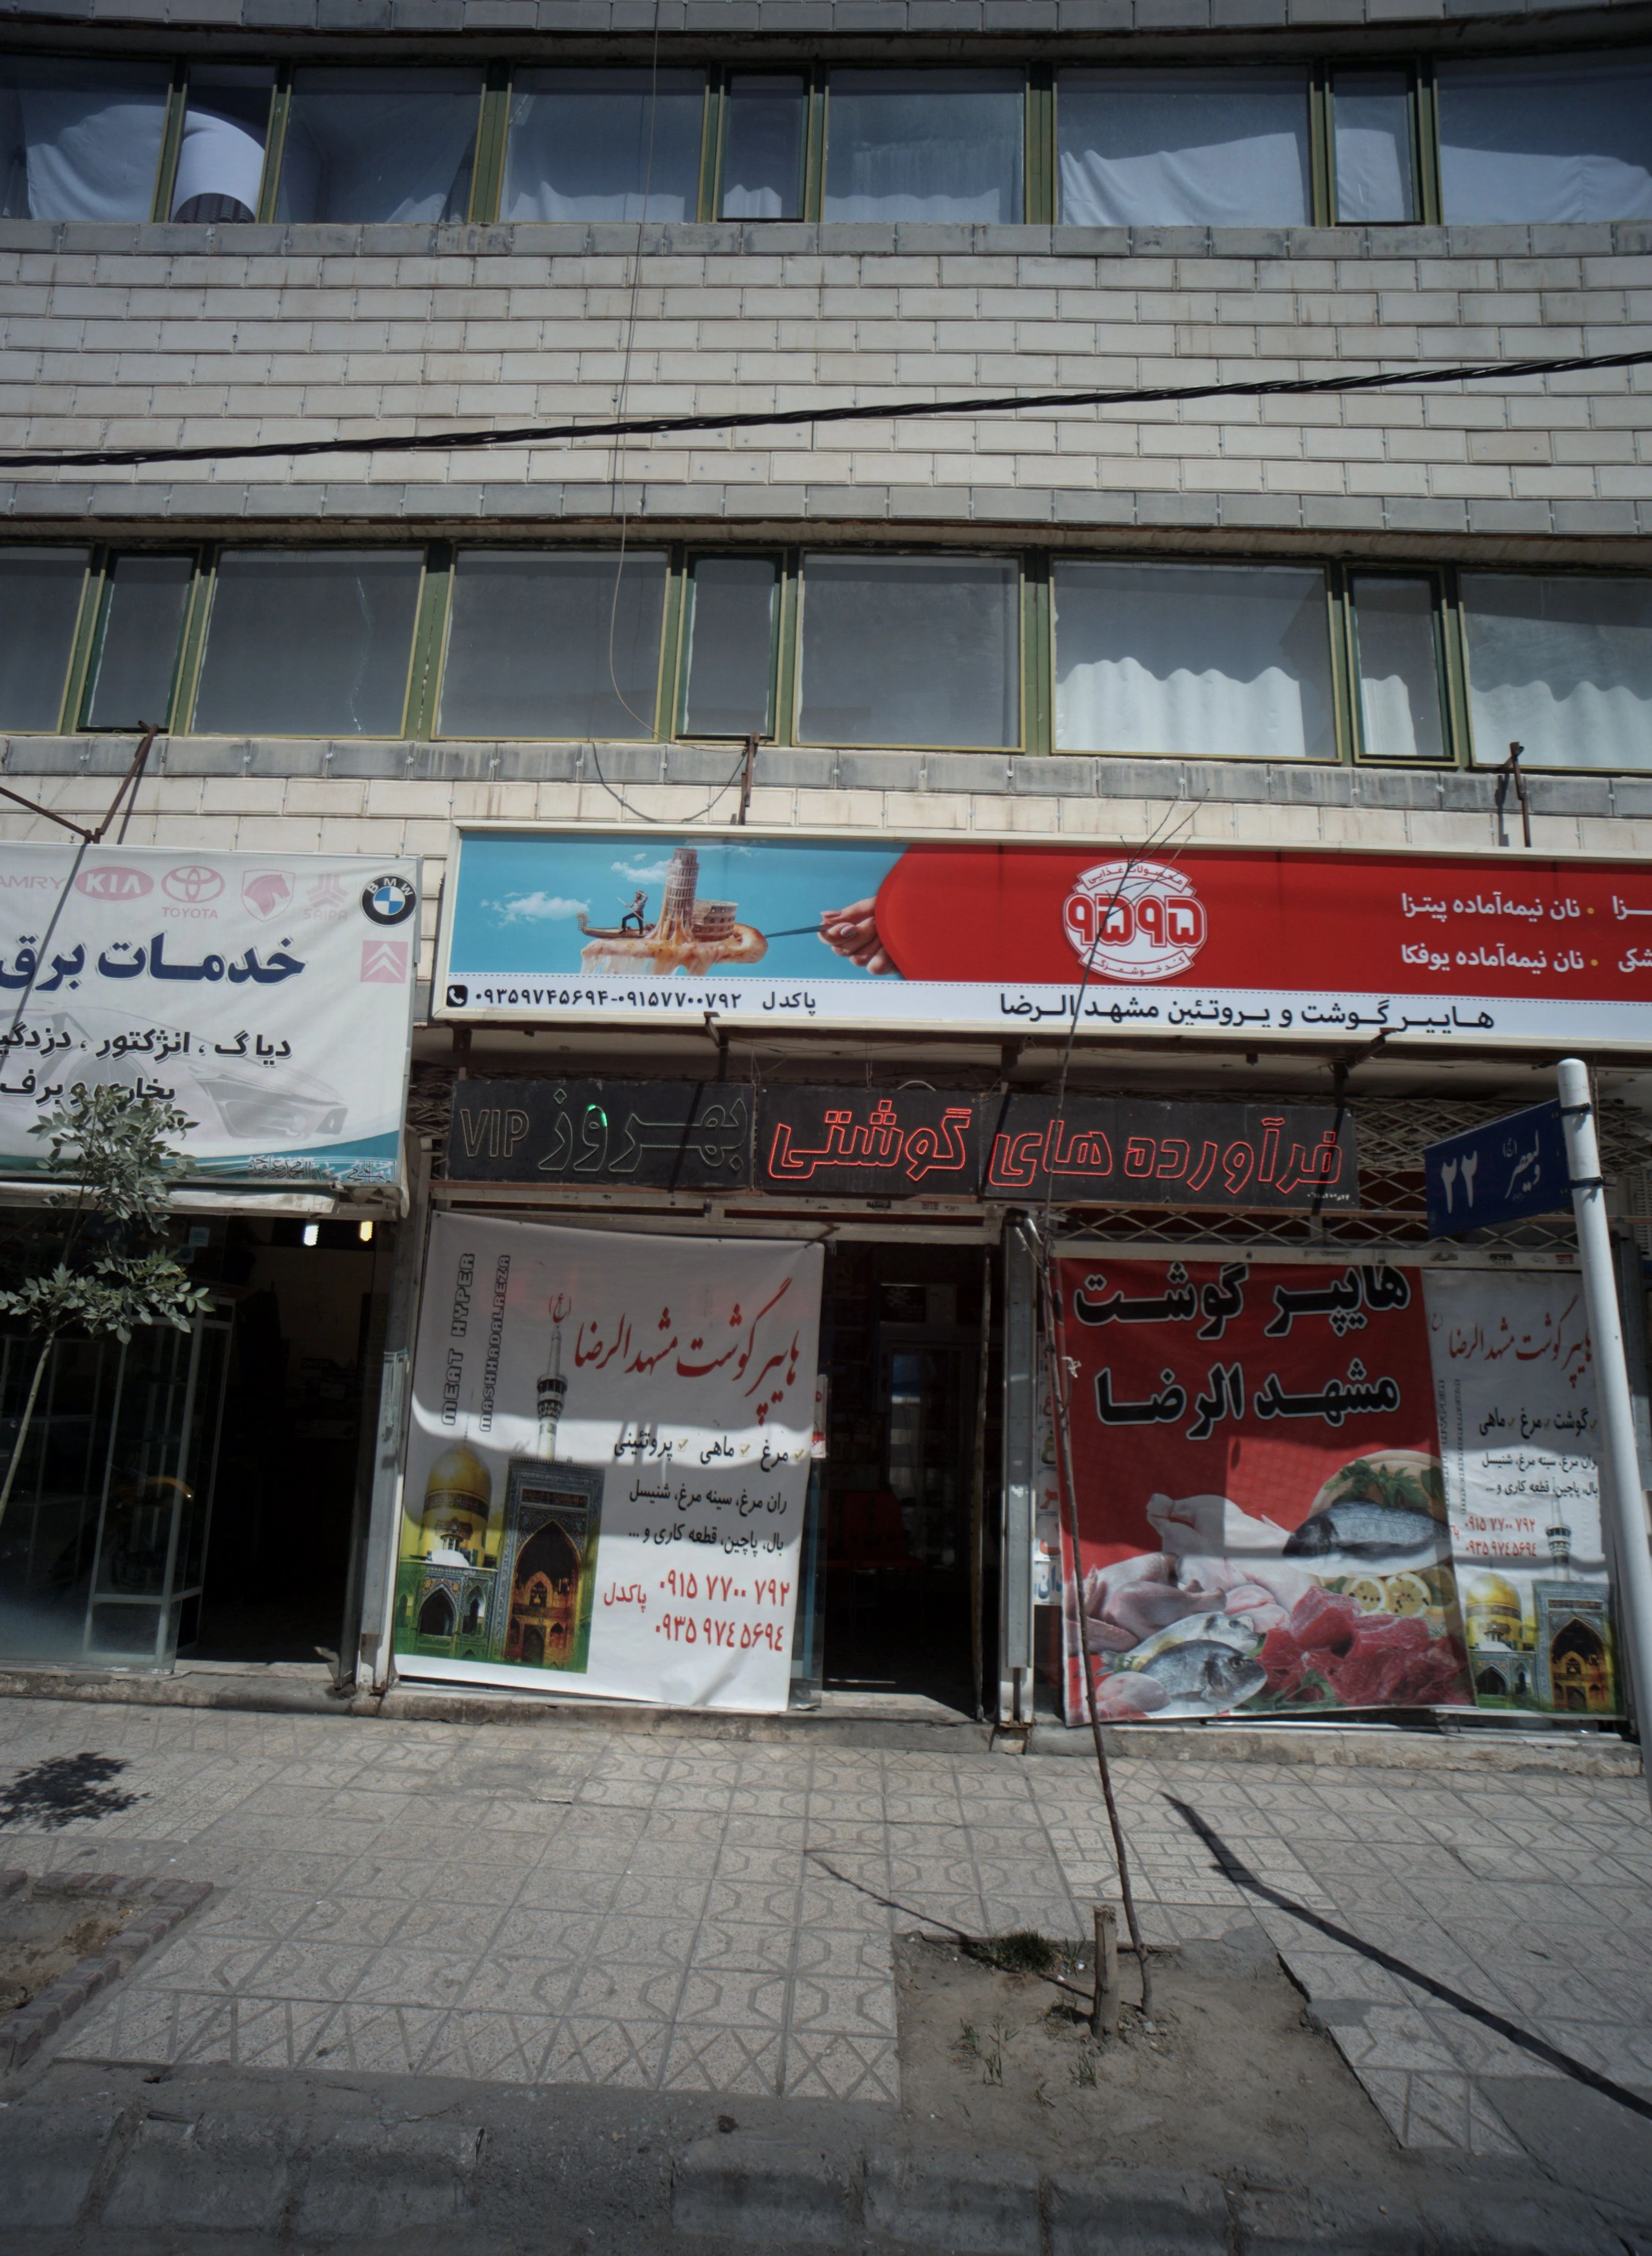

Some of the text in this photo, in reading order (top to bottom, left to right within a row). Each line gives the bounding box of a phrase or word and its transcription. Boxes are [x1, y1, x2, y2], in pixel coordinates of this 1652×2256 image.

[86, 874, 142, 893] KIA
[366, 877, 413, 897] BMW
[162, 907, 219, 919] TOYOTA
[303, 909, 348, 921] SAIPA
[1067, 895, 1203, 946] ۹۵۹۵
[1401, 893, 1447, 923] پیتزا
[1550, 898, 1580, 920] نان
[0, 931, 306, 991] خدمات برق
[1401, 942, 1450, 972] یوفکا
[1553, 950, 1584, 972] نان
[763, 991, 816, 1016] پاکدل
[1000, 994, 1077, 1022] الرضا
[1084, 996, 1159, 1024] مشهد
[1279, 1009, 1292, 1028] و
[1301, 1000, 1390, 1030] گوشت
[95, 1028, 190, 1062] انژکتور
[460, 1109, 530, 1157] VIP
[537, 1088, 748, 1173] بهروز
[768, 1099, 1343, 1195] فرآورده های گوشتی
[1441, 1149, 1478, 1214] ۲۲
[1074, 1261, 1411, 1341] هایپر گوشت
[442, 1252, 475, 1425] MEAT HYPER
[480, 1254, 510, 1433] MASHHADALREZA
[574, 1312, 632, 1369] الرضا
[624, 1306, 678, 1375] مشهد
[676, 1277, 793, 1381] گوشت
[745, 1330, 800, 1427] هایپر
[1094, 1357, 1400, 1440] مشهد الرضا
[1479, 1407, 1589, 1440] گوشت مرغ ماهی
[614, 1430, 789, 1472] مرغ ماهی پروتئینی
[629, 1479, 671, 1504] شنیسل
[706, 1489, 732, 1511] سینه
[767, 1492, 787, 1515] ران
[643, 1528, 650, 1544] و
[654, 1523, 686, 1544] کاری
[688, 1526, 718, 1544] قطعه
[604, 1582, 647, 1613] پاکدل
